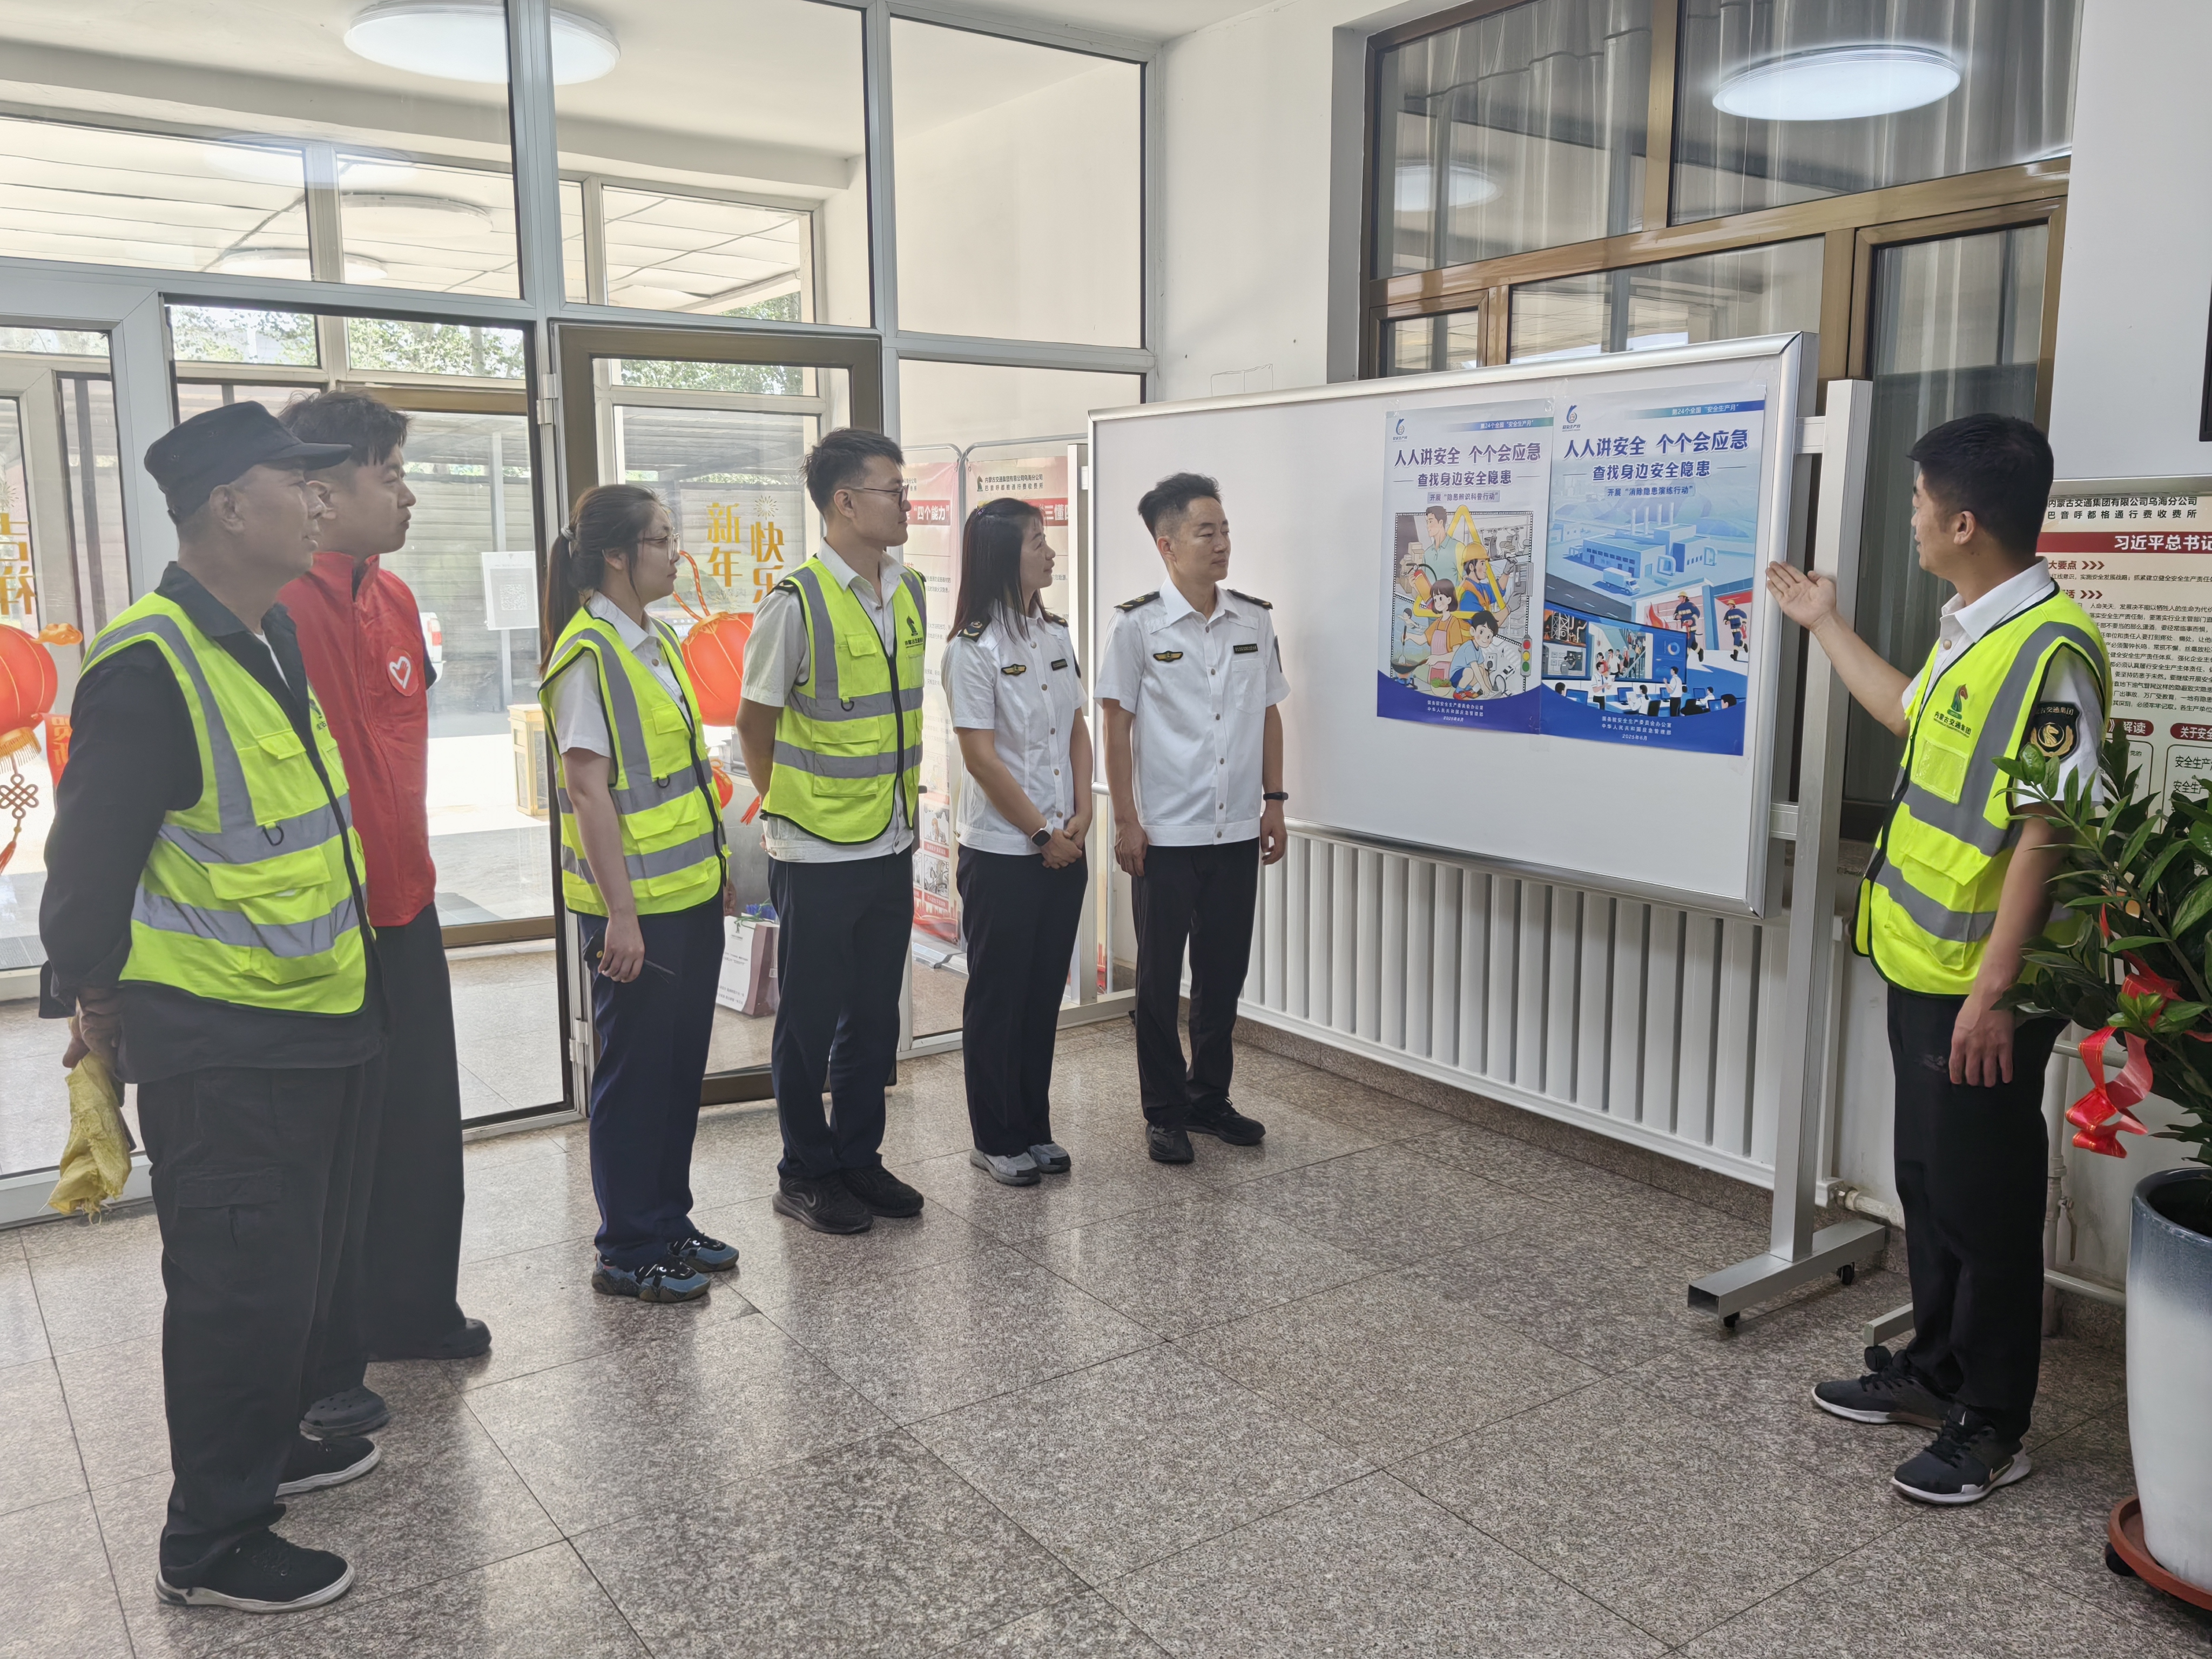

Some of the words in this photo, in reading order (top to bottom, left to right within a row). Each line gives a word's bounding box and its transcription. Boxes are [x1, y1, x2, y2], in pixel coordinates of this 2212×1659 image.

[1563, 435, 1647, 459] 人人讲安全
[1656, 429, 1749, 454] 个个会应急
[1394, 447, 1461, 468] 人人讲安全
[1468, 442, 1541, 463] 个个会应急
[1417, 469, 1512, 487] 查找身边安全隐患
[1592, 460, 1711, 481] 查找身边安全隐患
[2048, 496, 2197, 508] 内蒙古交通集团有限公司乌海分公司
[907, 505, 949, 521] “四个能力”
[2047, 509, 2197, 520] 巴音呼都格通行费收费所
[707, 502, 743, 587] 新年
[2114, 535, 2212, 551] 习近平总书记
[750, 522, 785, 604] 快乐
[1934, 711, 1972, 735] 内蒙古交通集团
[2175, 755, 2212, 771] 安全生产
